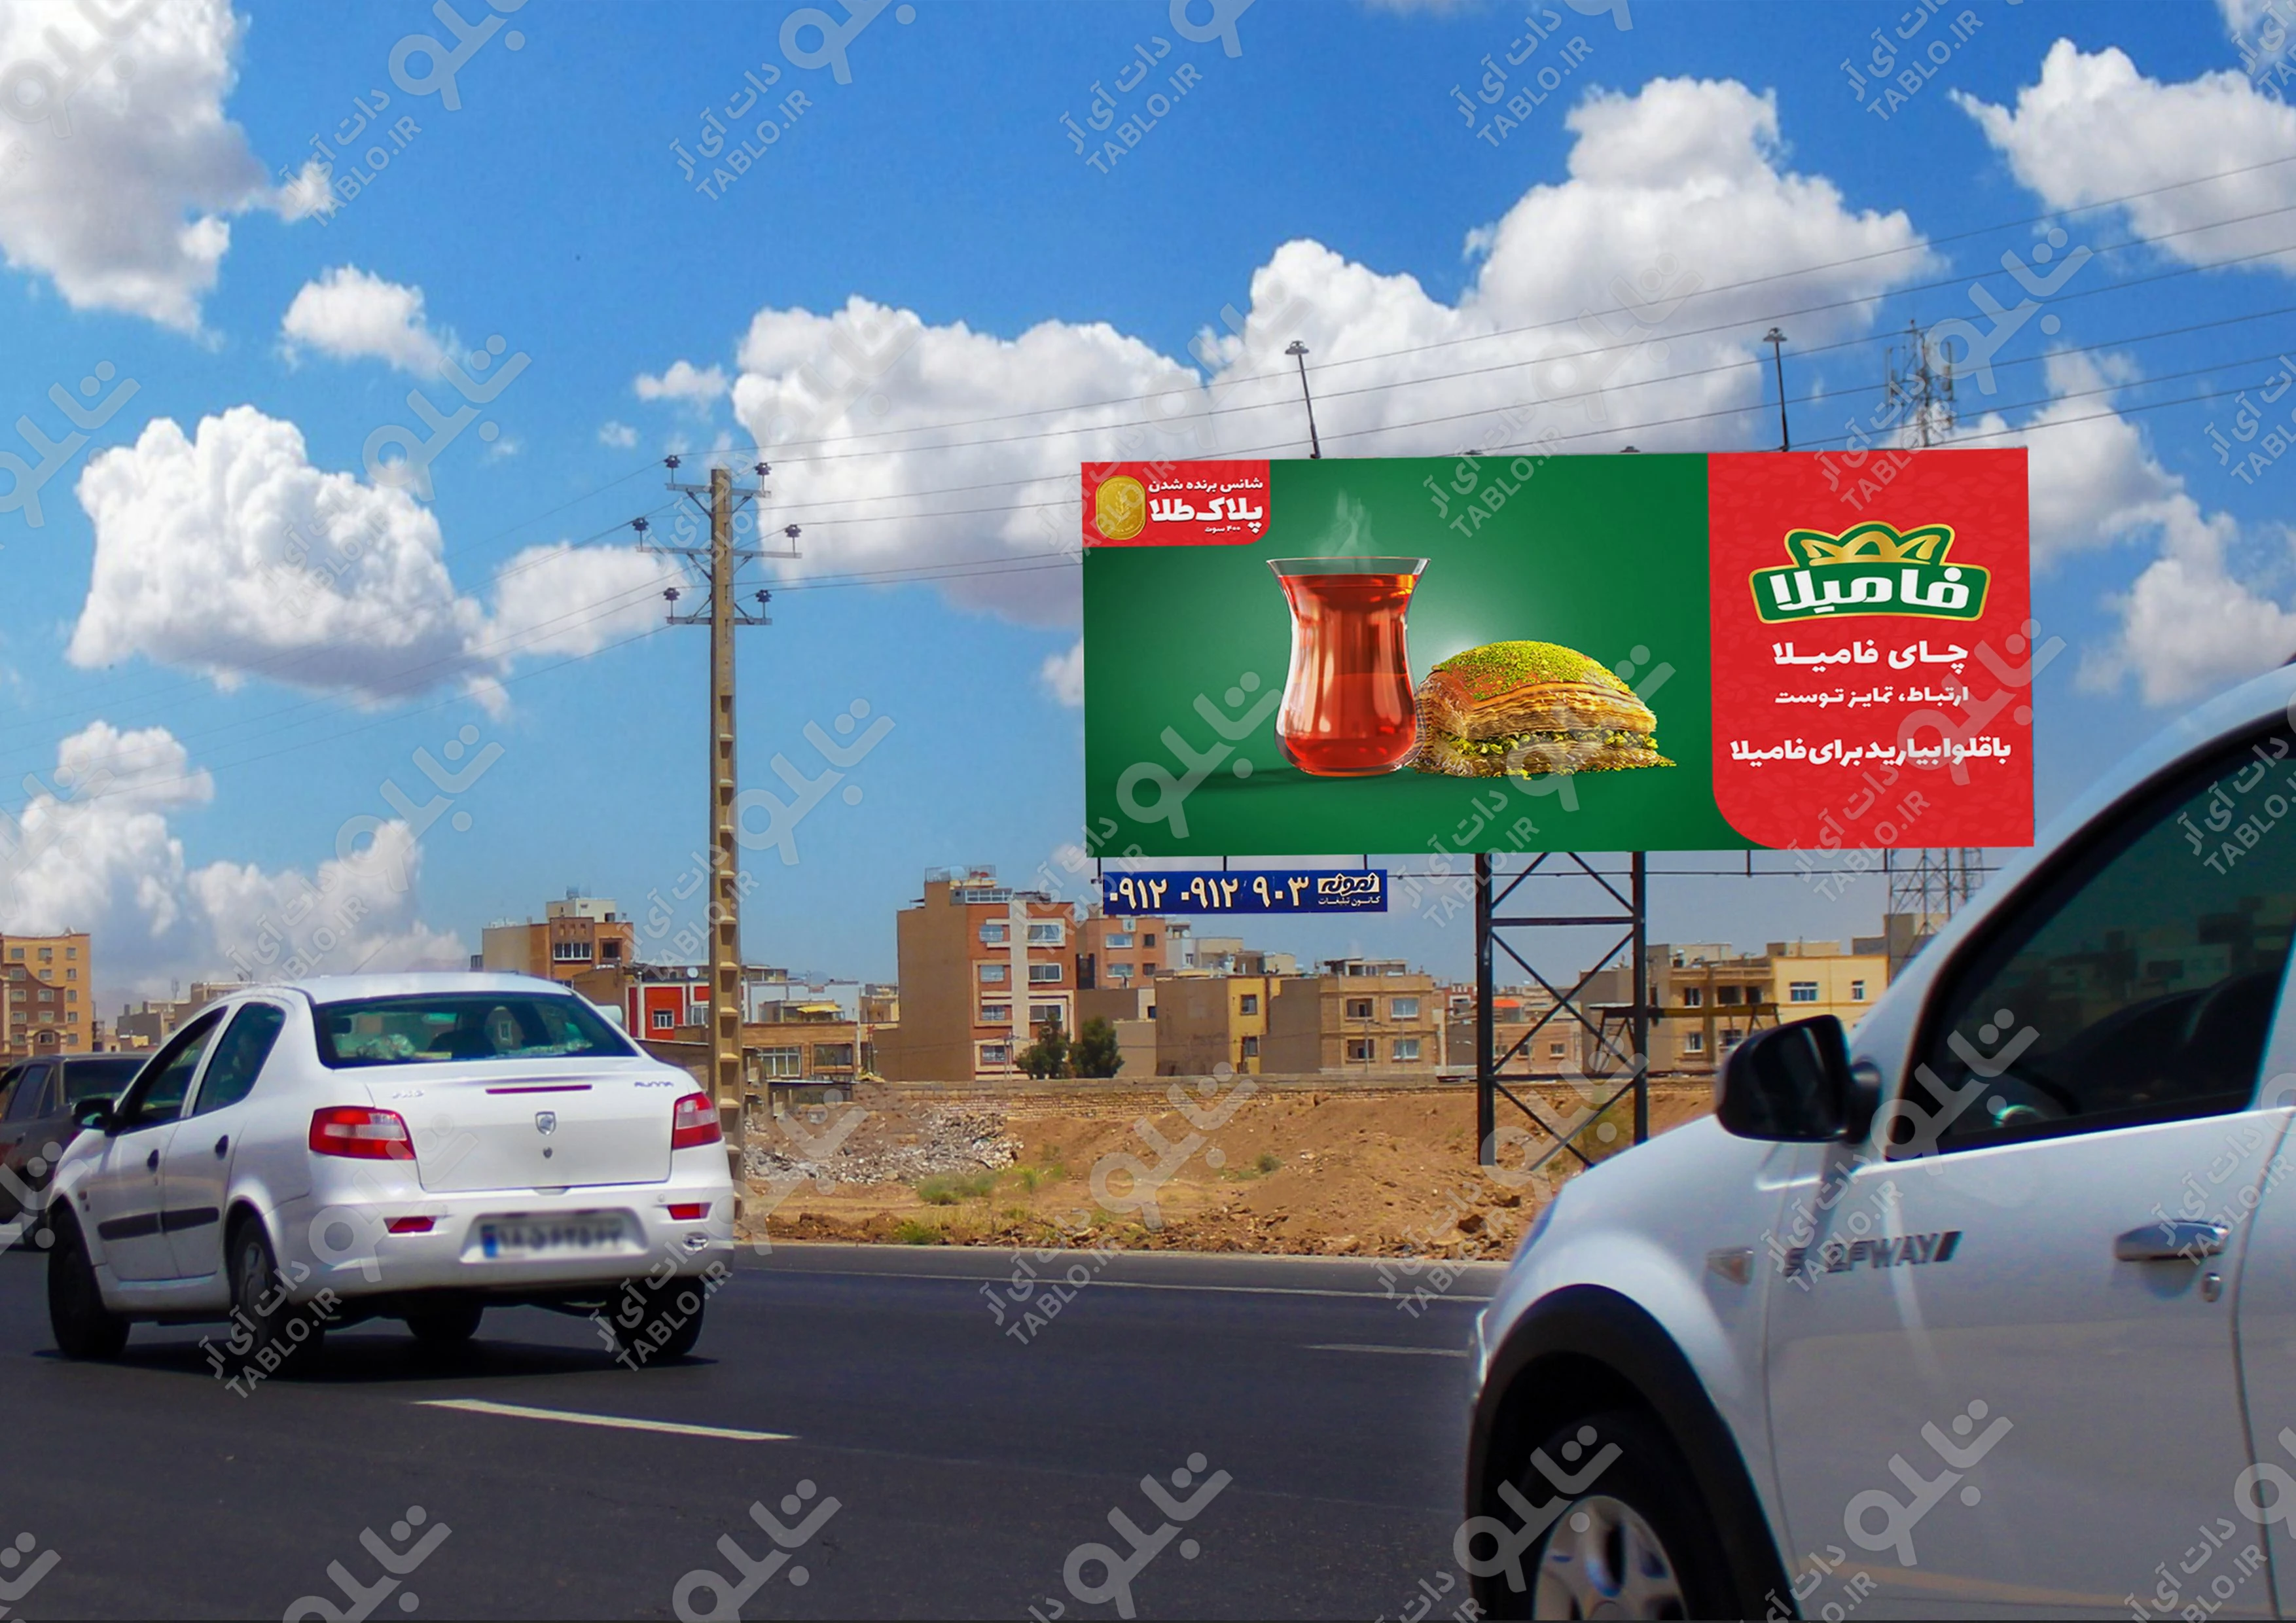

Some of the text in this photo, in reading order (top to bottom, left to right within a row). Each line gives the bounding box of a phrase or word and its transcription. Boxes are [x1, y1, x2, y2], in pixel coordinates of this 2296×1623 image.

[1148, 477, 1263, 492] شانس برنده شدن
[1149, 498, 1195, 522] طلا
[1196, 497, 1263, 533] پلاک
[1769, 567, 1969, 614] فامیلا
[1772, 640, 1969, 674] چای فامیلا
[1775, 688, 1844, 708] توست
[1847, 686, 1893, 708] تمایز
[1730, 738, 1806, 767] فامیلا
[1808, 739, 1863, 766] برای
[1865, 738, 1940, 766] بیارید
[1109, 876, 1309, 910] ۰۹۱۲ ۰۹۱۲ ۹۰۳
[1320, 874, 1376, 896] نمونه
[1318, 896, 1381, 906] کانون تبلیغات
